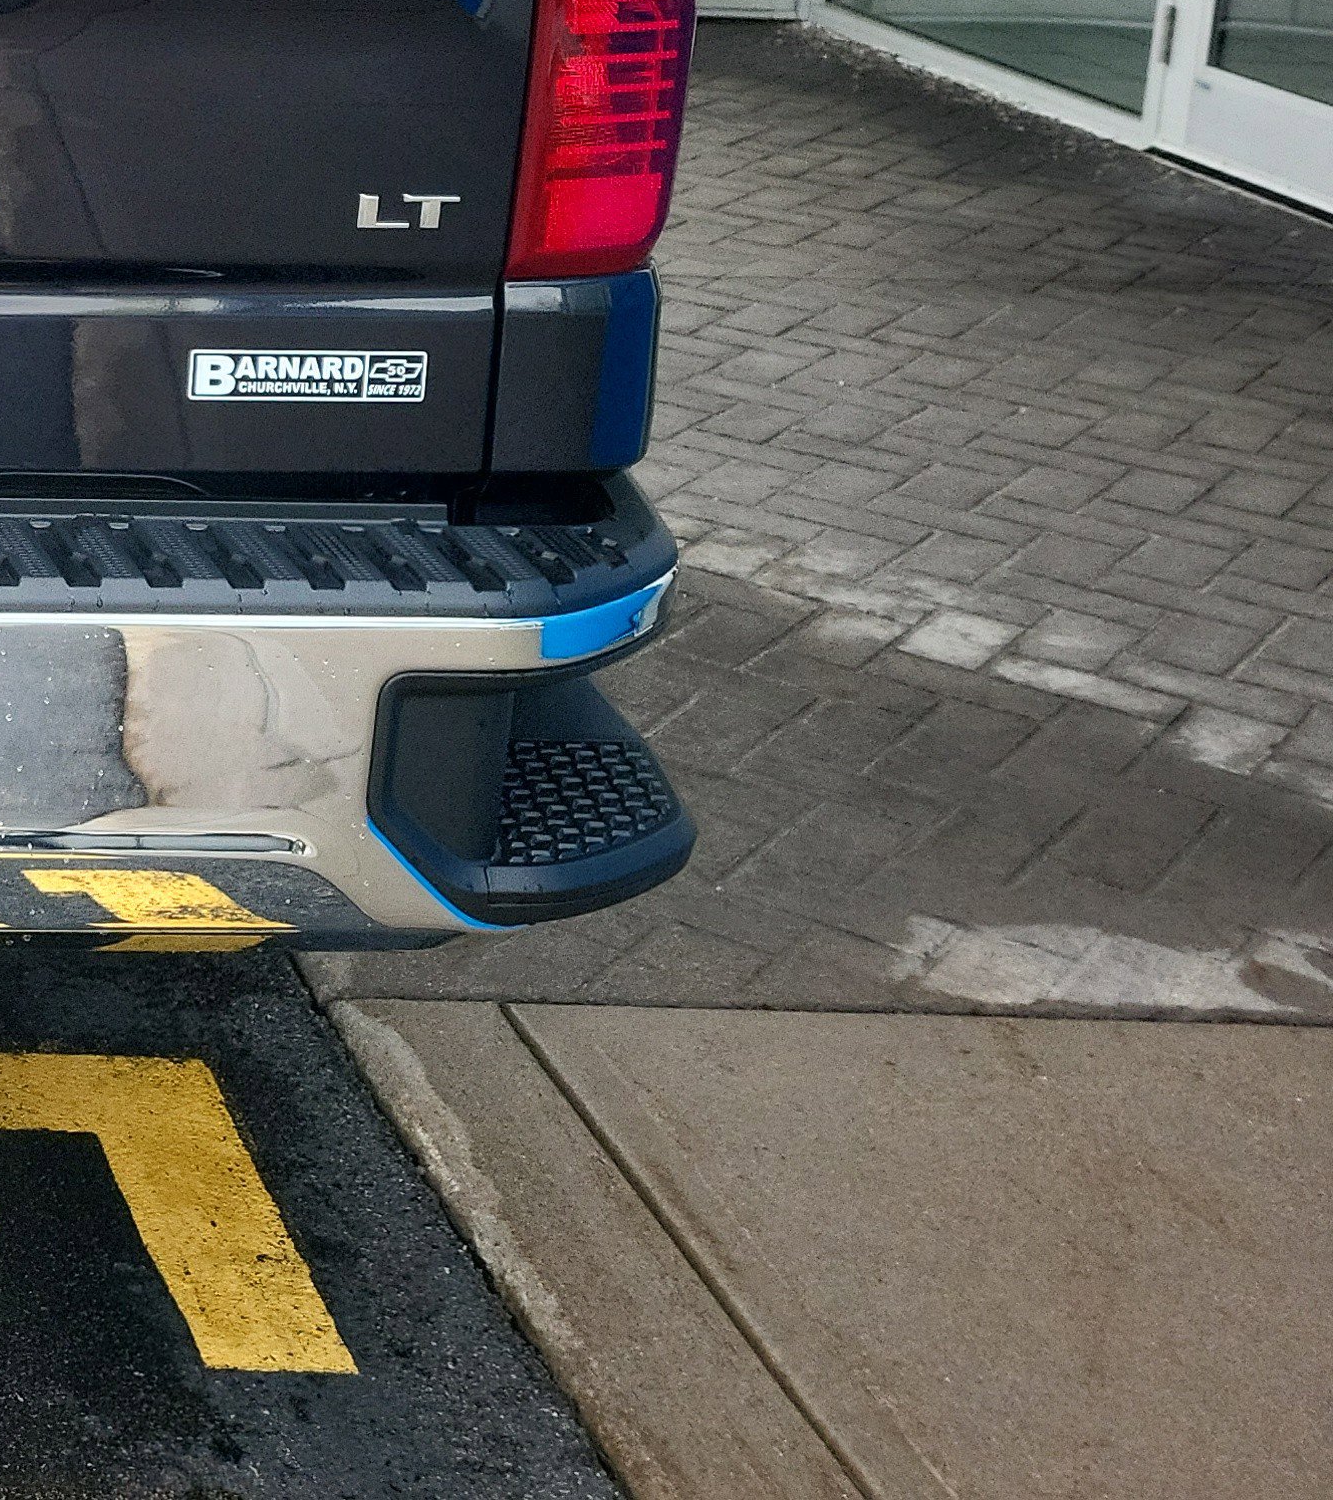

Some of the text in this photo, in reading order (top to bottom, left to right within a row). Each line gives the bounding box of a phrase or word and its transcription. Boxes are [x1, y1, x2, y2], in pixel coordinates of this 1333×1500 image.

[356, 193, 462, 229] LT
[193, 354, 364, 396] BARNARD
[238, 381, 359, 396] CHURCHVILLE, N.Y.
[367, 384, 422, 396] SINCE 1972
